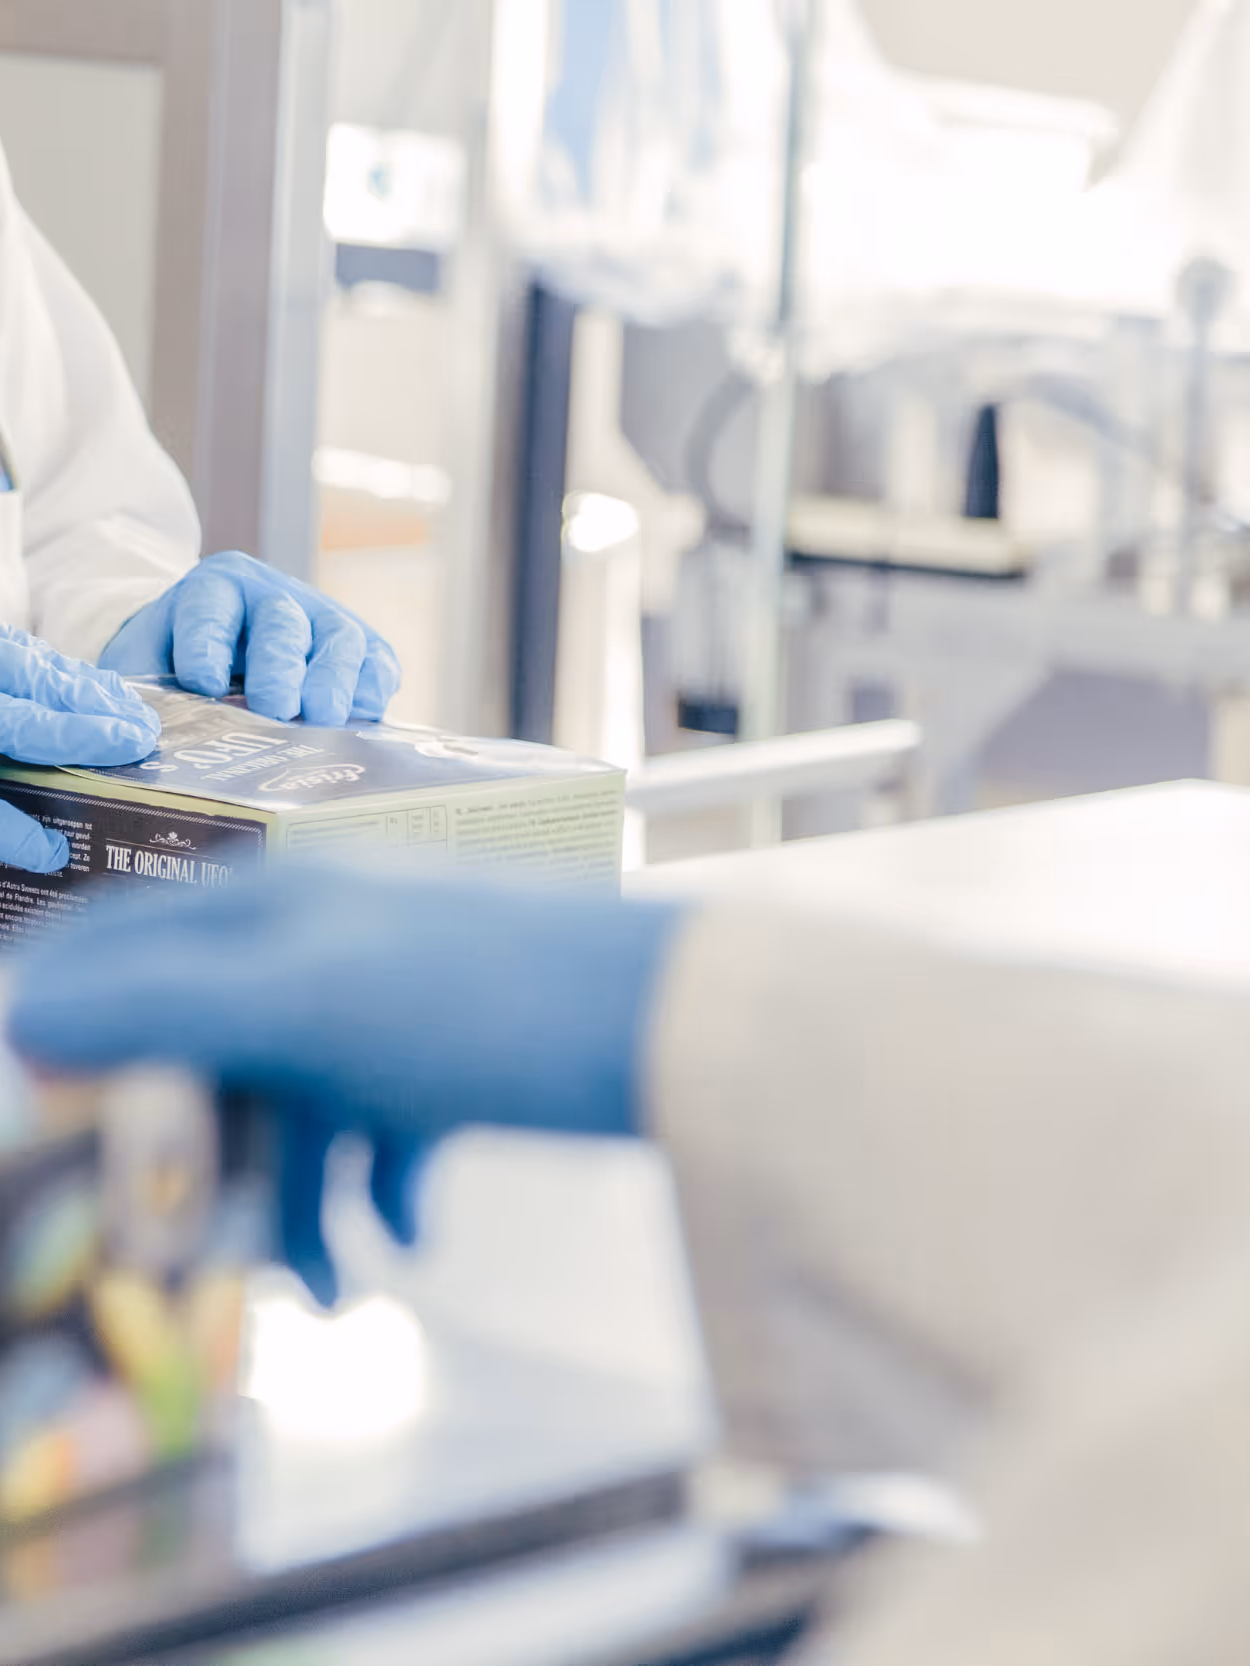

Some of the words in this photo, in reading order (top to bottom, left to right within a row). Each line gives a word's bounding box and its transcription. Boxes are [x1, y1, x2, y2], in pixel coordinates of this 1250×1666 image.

[279, 744, 326, 760] THE
[199, 754, 288, 782] ORIGINAL
[72, 842, 91, 851] worden
[83, 854, 91, 862] Ze
[106, 844, 132, 873] THE
[134, 849, 198, 884] ORIGINAL
[201, 861, 234, 889] UFO'
[36, 897, 46, 906] Les
